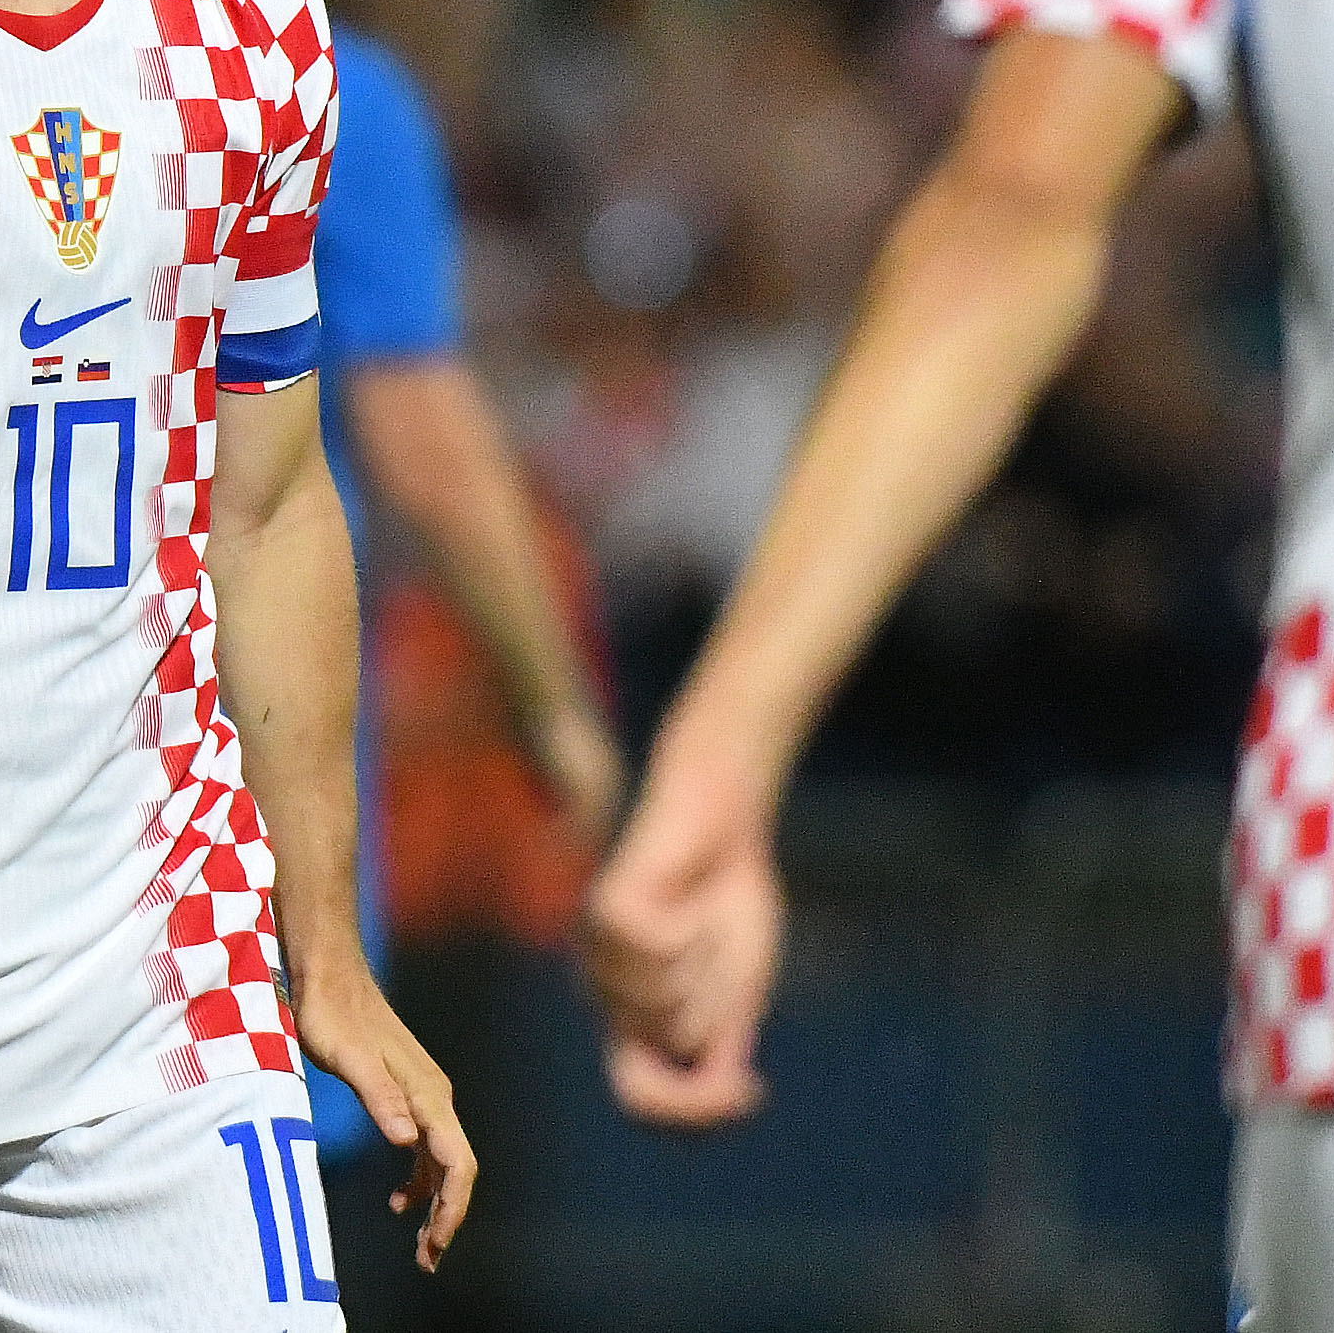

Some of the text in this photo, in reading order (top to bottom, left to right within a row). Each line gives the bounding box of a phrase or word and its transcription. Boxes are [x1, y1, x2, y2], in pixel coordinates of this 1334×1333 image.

[54, 120, 80, 206] HNS
[6, 396, 137, 592] 10
[218, 1116, 340, 1303] 10
